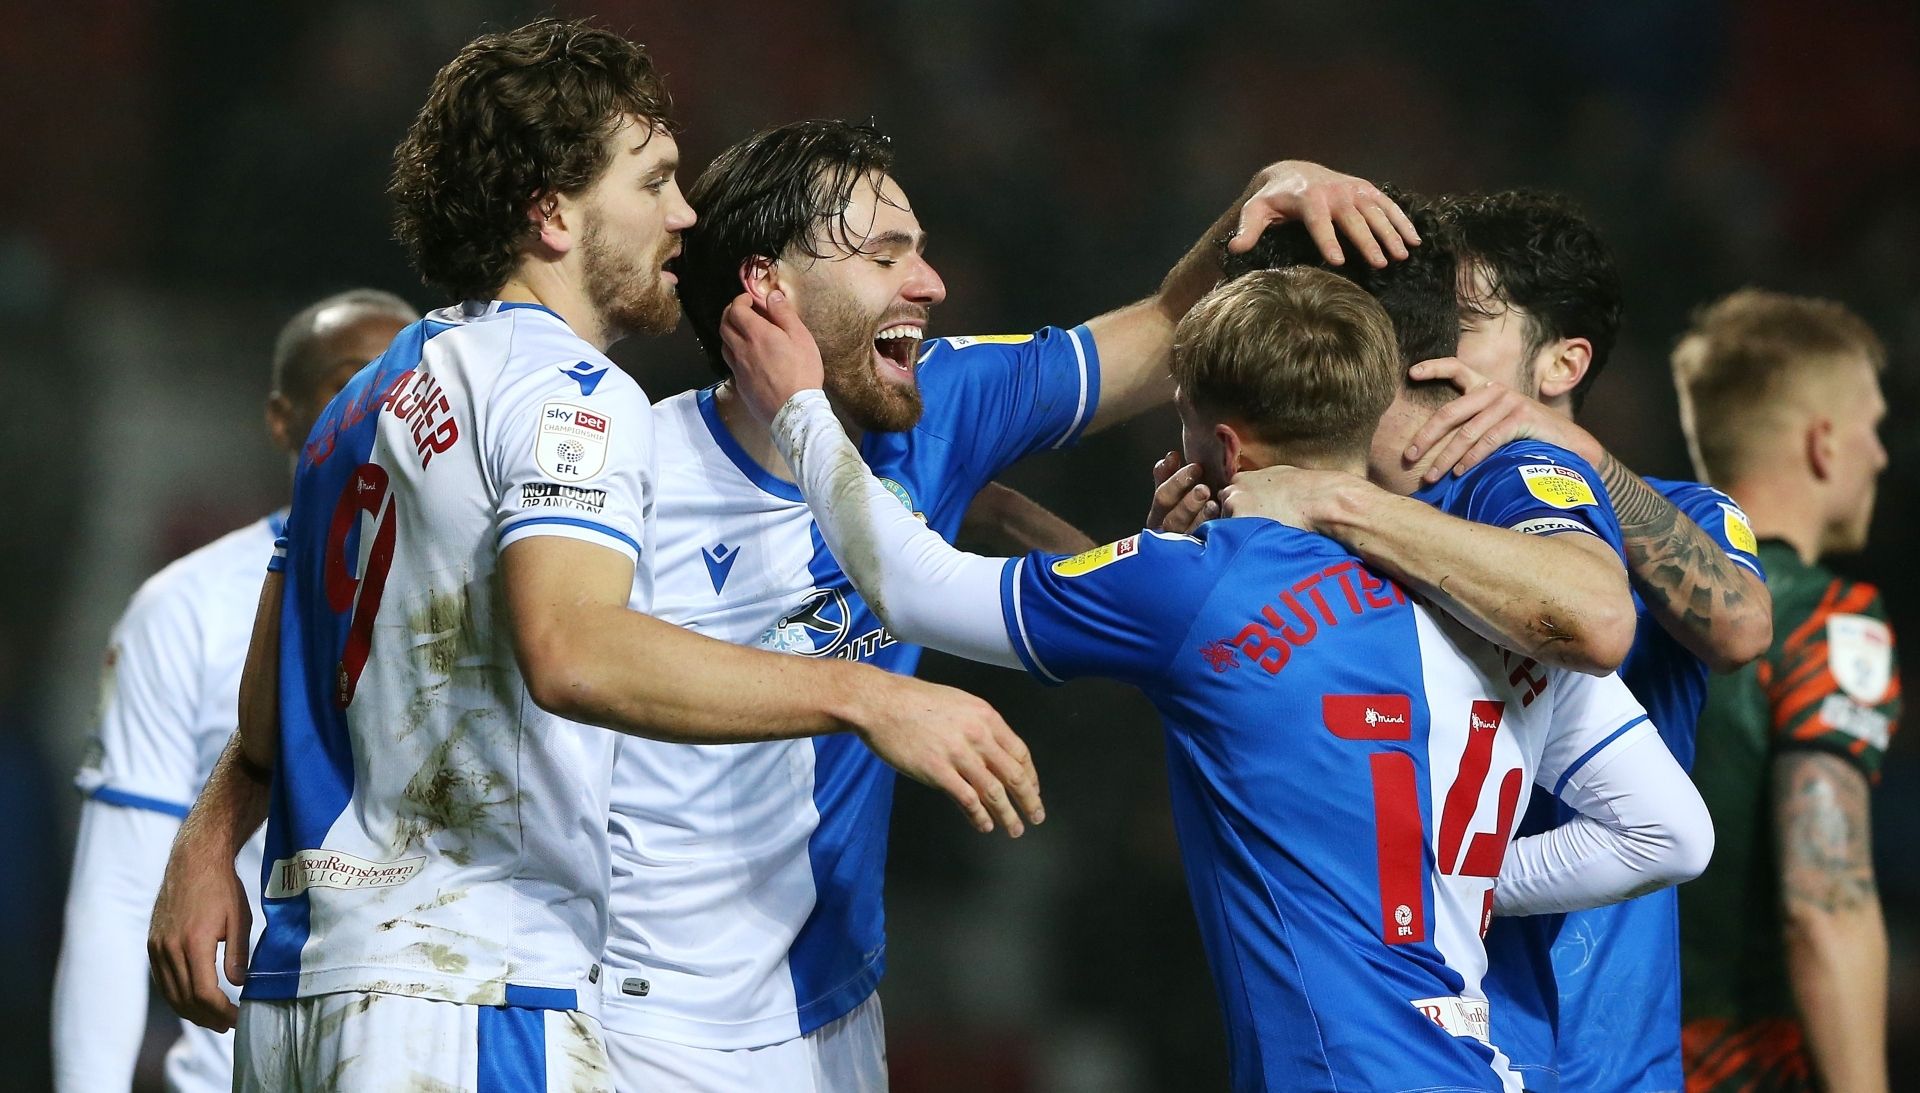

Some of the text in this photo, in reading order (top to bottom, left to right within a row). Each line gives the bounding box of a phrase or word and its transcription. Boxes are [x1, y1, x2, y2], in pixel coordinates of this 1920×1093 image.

[546, 408, 604, 431] sky bet
[544, 423, 604, 441] CHAMPIONSHIP
[556, 463, 579, 476] EFL
[1526, 467, 1551, 475] sky
[558, 486, 607, 507] TODAY
[324, 462, 396, 709] 9
[1321, 694, 1523, 945] 14
[1397, 926, 1413, 936] EFL
